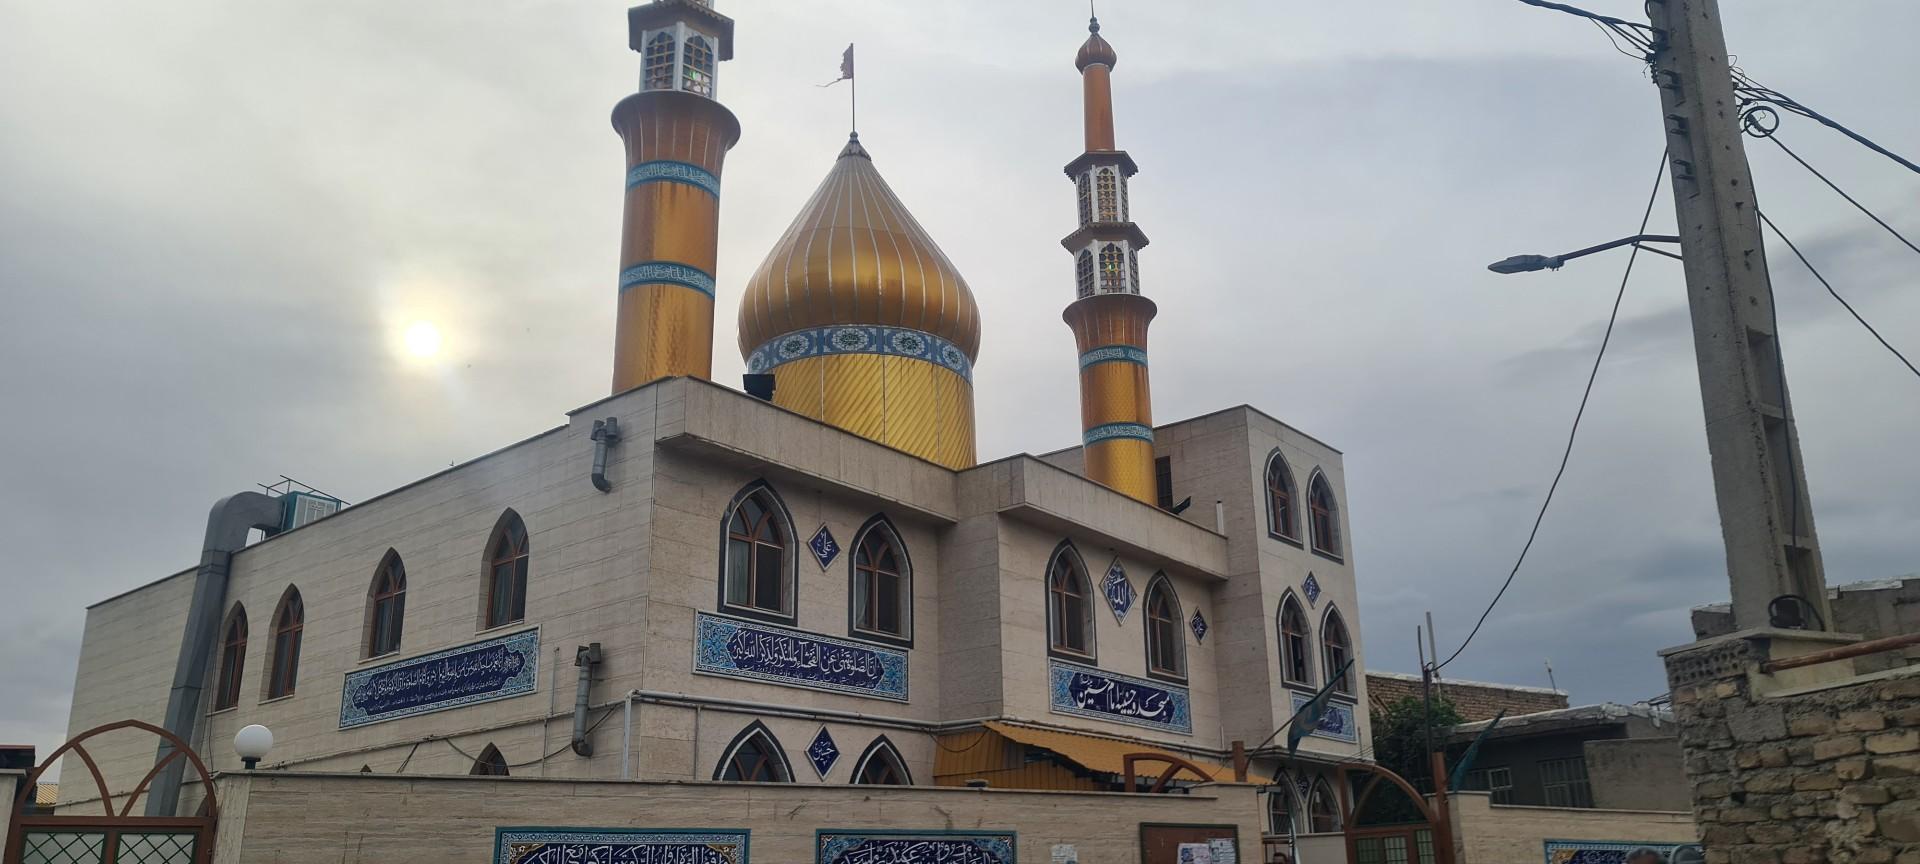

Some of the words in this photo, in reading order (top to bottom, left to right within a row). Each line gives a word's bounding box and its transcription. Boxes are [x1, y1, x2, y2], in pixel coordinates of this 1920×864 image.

[1112, 578, 1128, 613] الله
[1077, 679, 1110, 709] حسین
[1136, 692, 1170, 717] مسجد
